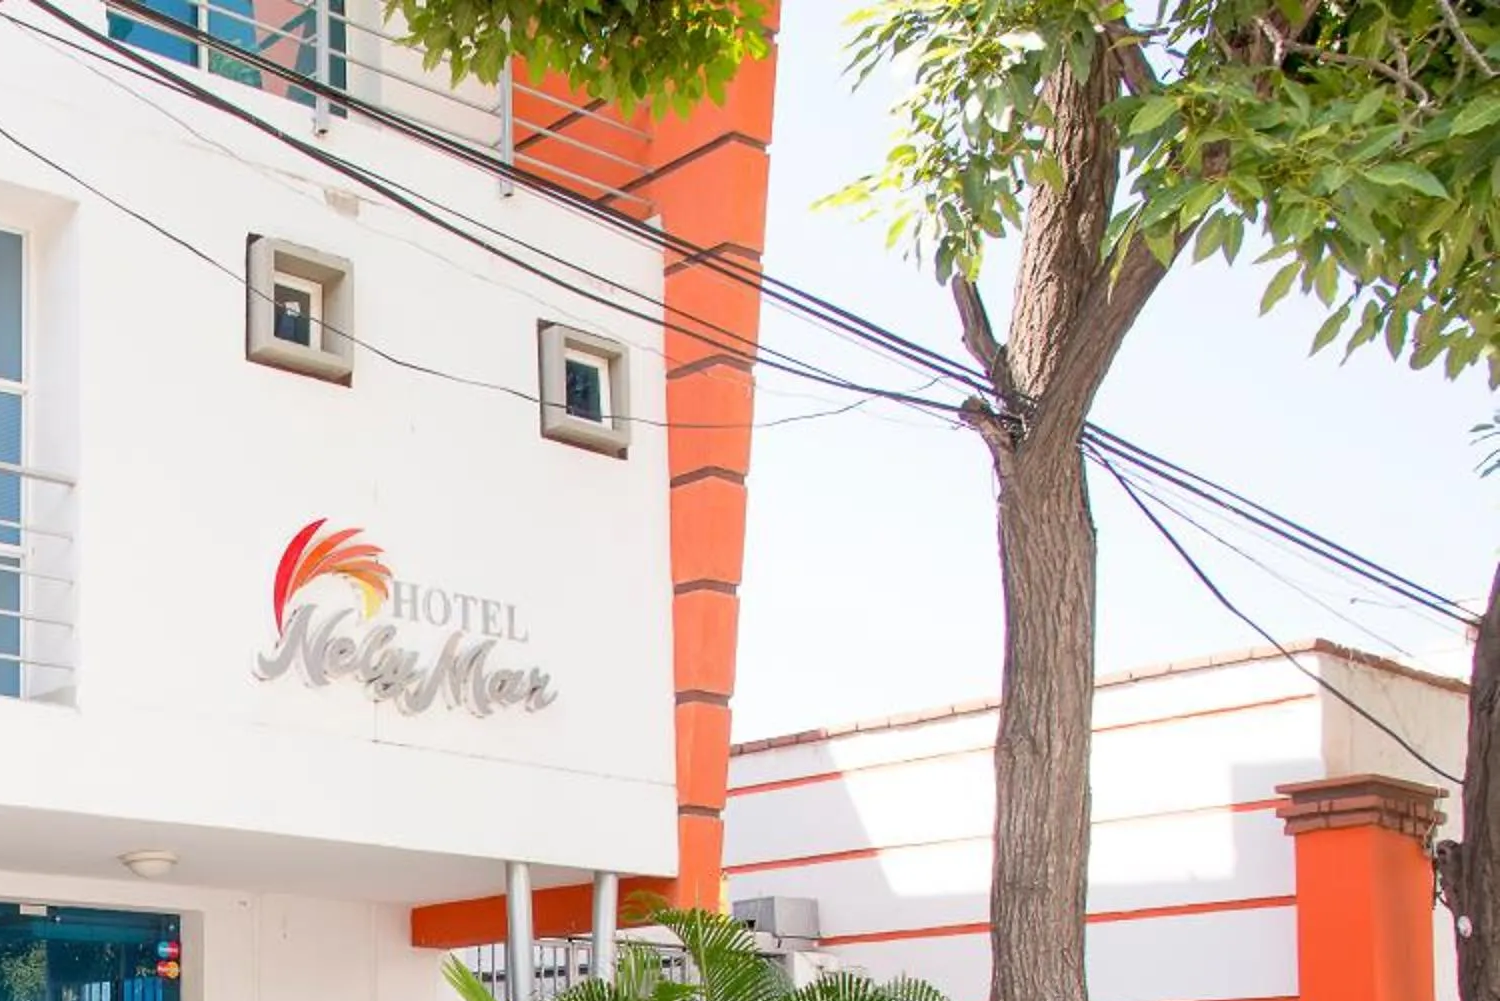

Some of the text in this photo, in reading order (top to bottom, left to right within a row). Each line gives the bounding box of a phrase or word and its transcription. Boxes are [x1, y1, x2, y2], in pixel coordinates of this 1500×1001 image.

[391, 579, 529, 643] HOTEL
[254, 603, 558, 718] Nely Mar
